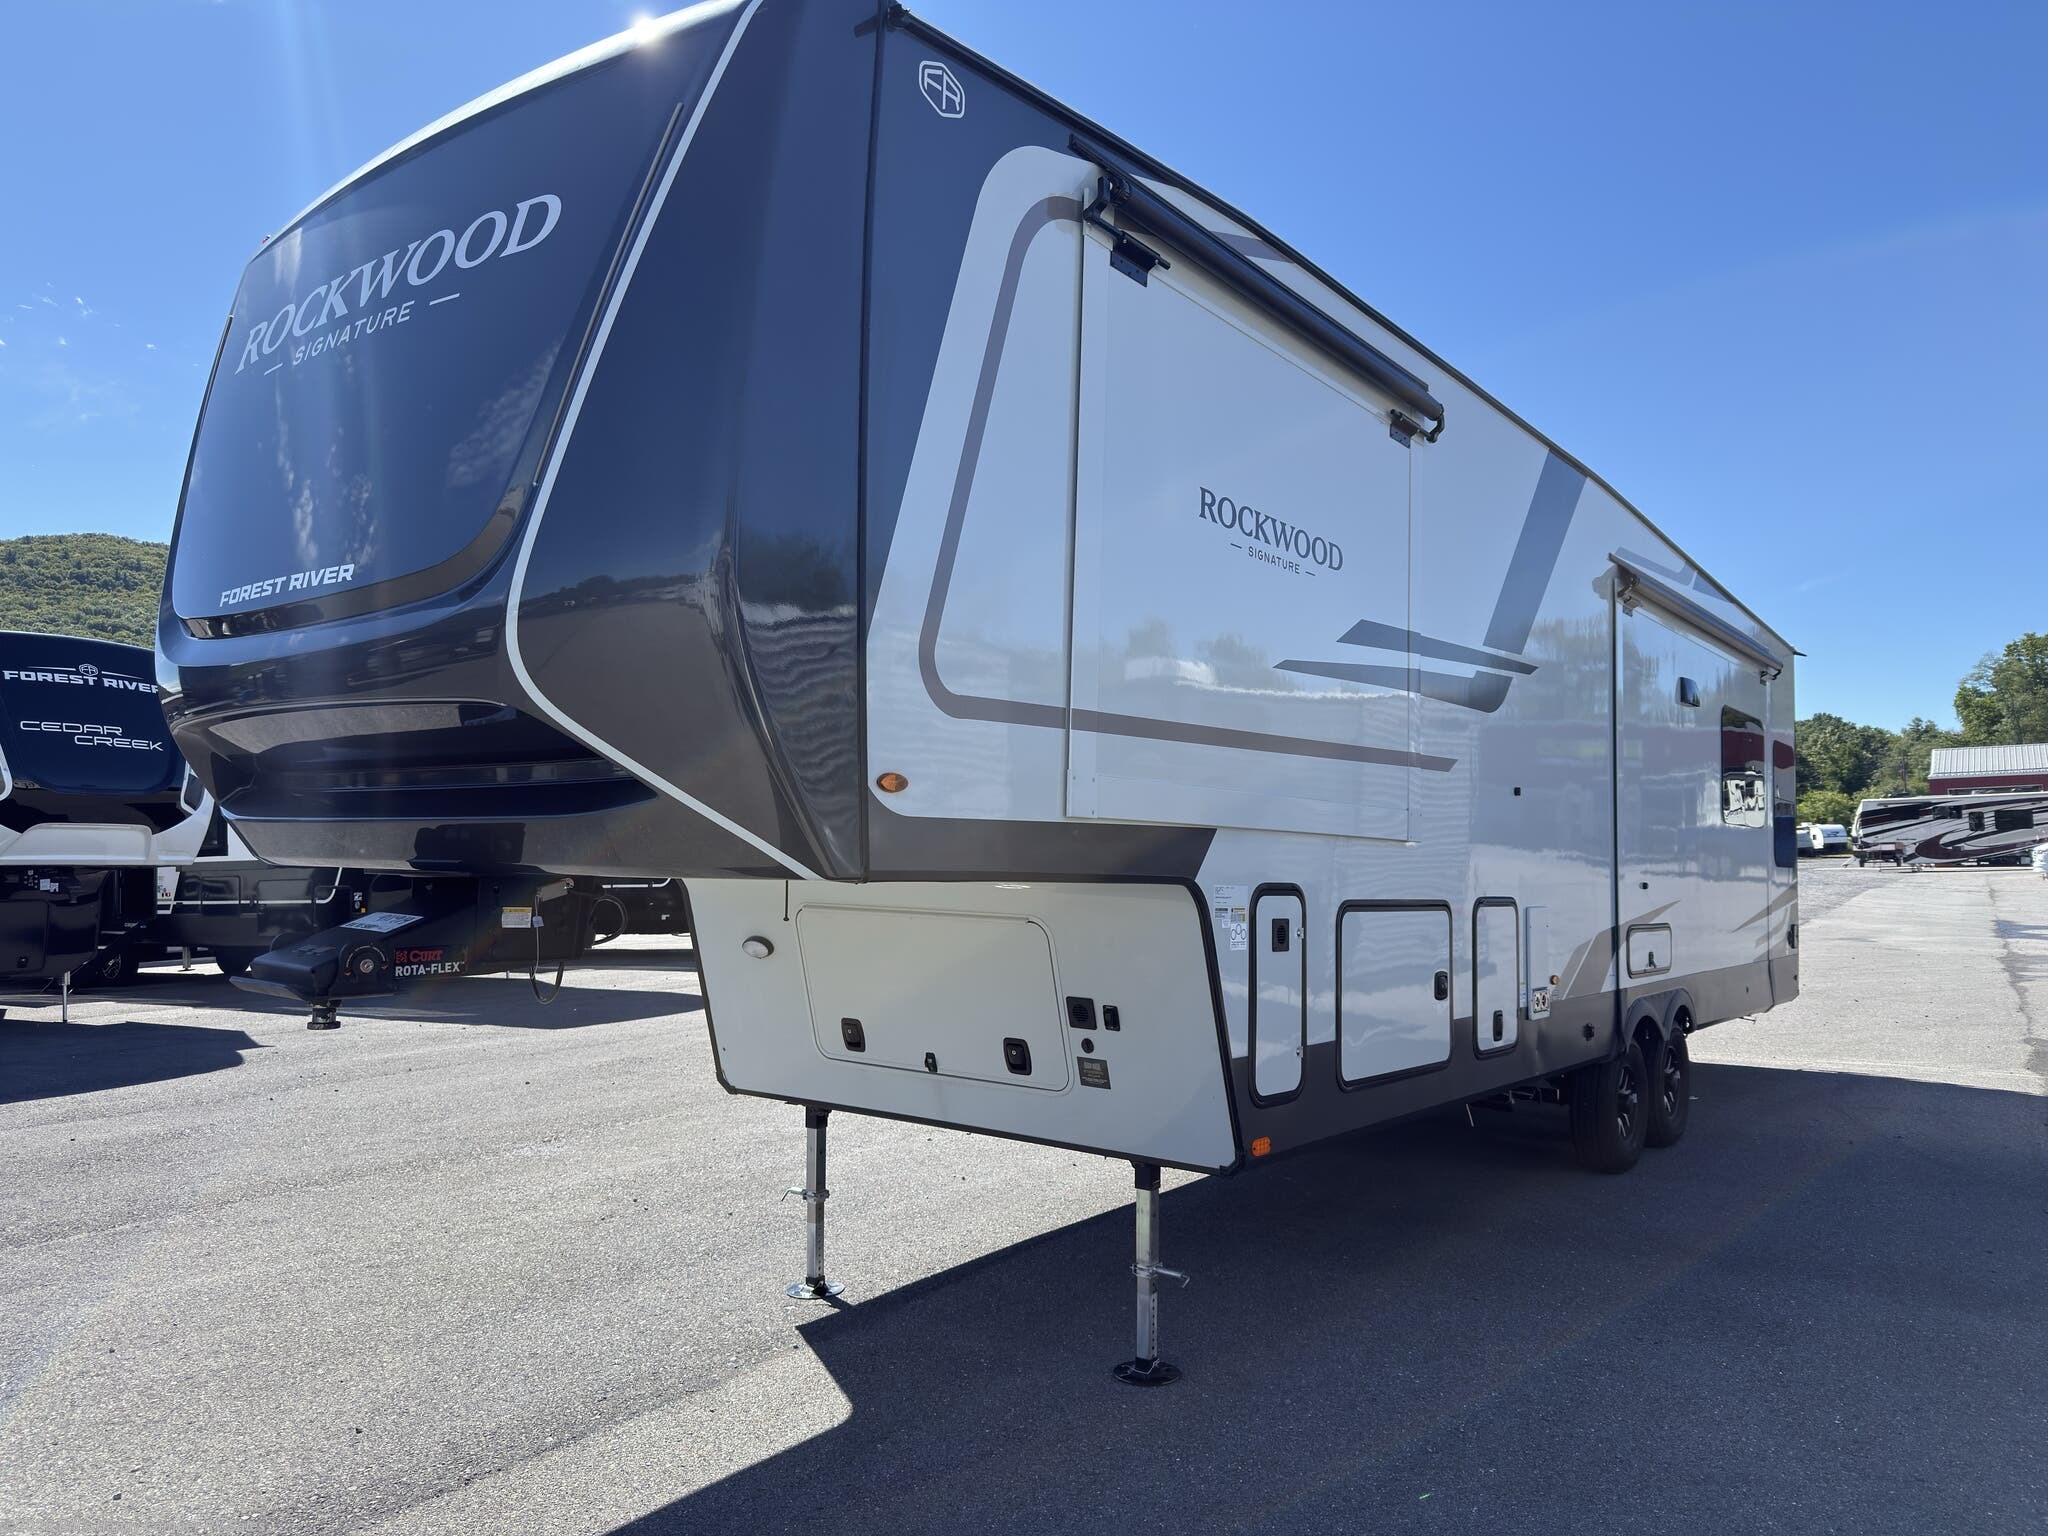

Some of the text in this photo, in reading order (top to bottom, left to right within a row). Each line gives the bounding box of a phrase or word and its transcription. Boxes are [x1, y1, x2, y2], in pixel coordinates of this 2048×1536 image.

[235, 194, 562, 375] ROCKWOOD
[292, 300, 415, 366] SIGNATURE
[1199, 487, 1344, 571] ROCKWOOD
[1248, 546, 1301, 575] SIGNATURE
[219, 563, 355, 608] FOREST RIVER
[2, 670, 98, 686] FOREST
[20, 720, 122, 736] CEDAR
[74, 735, 164, 752] CREEK
